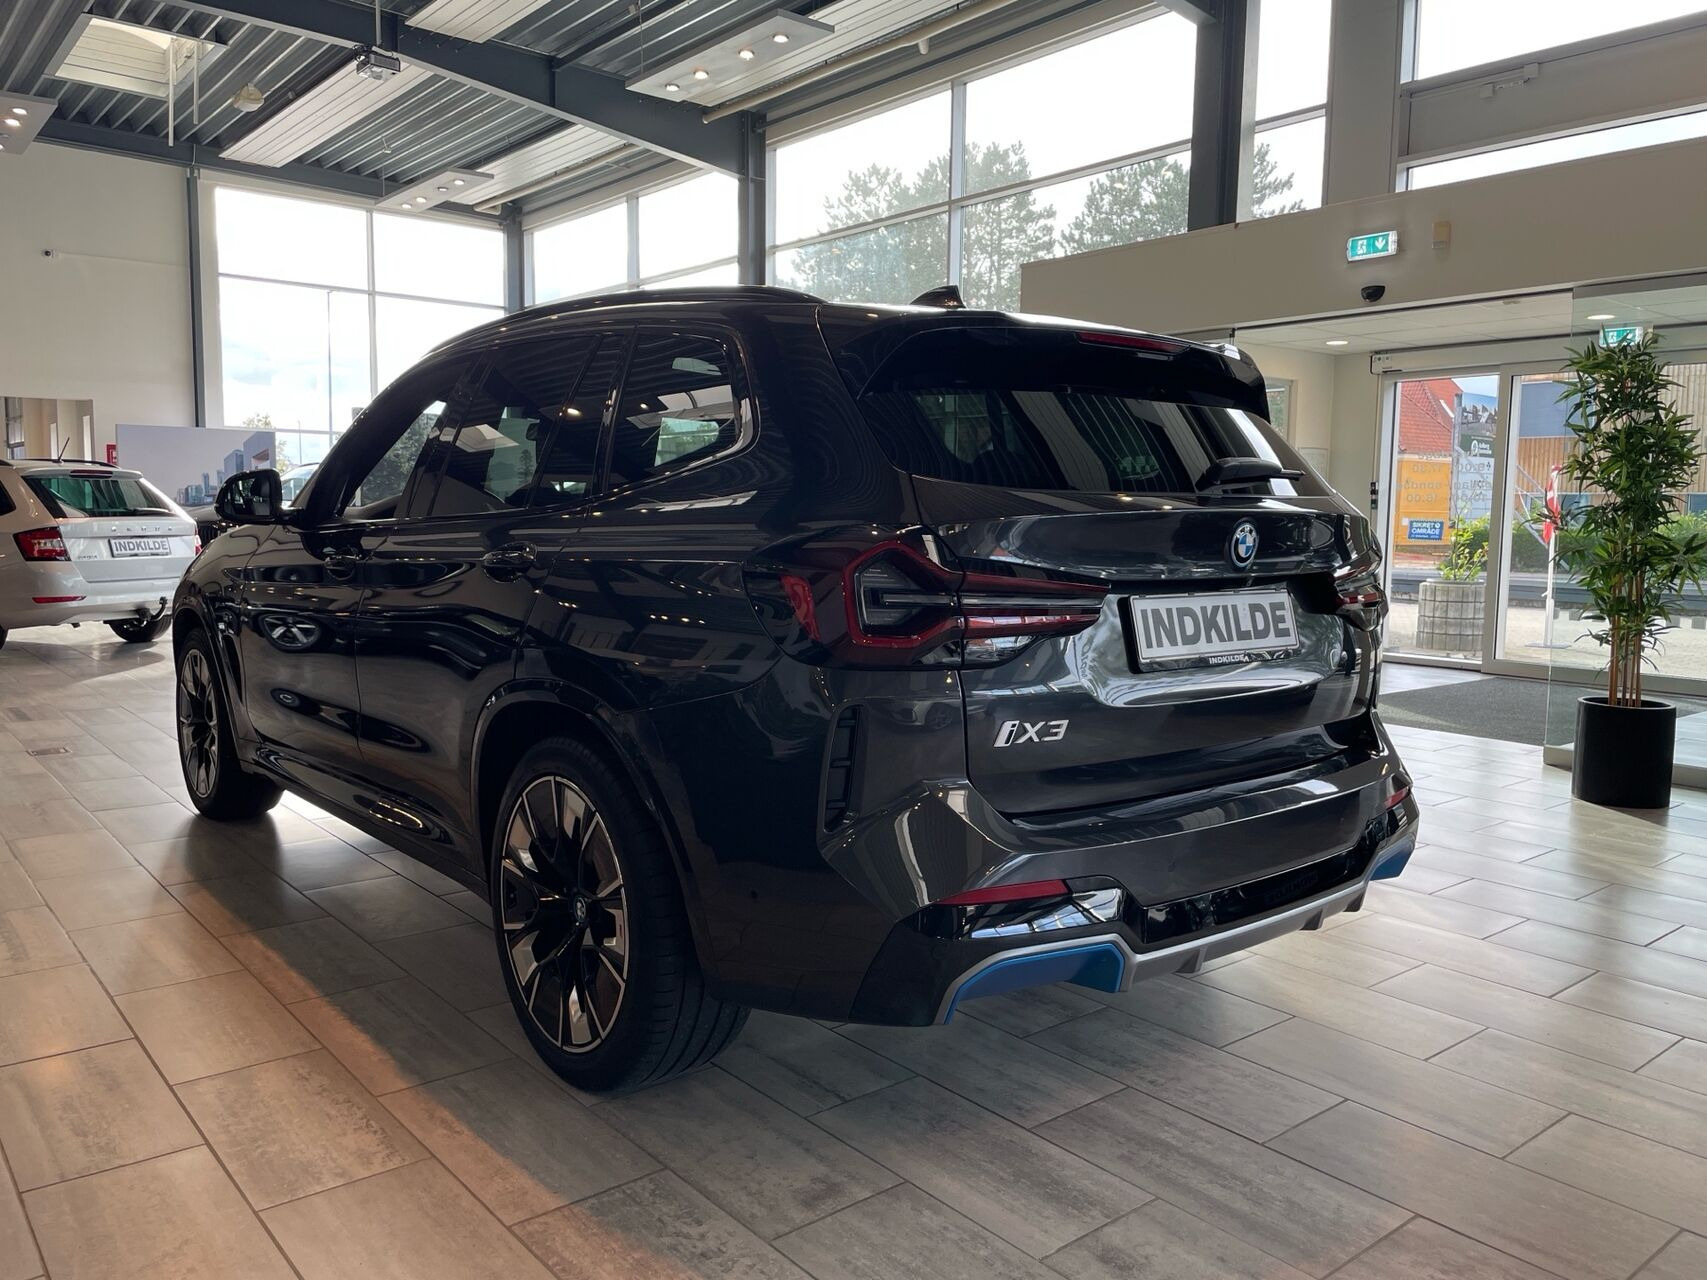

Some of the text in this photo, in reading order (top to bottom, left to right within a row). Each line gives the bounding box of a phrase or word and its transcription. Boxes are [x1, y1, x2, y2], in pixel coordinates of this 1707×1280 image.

[114, 540, 168, 552] INDKILDE
[1140, 601, 1292, 649] INDKILDE
[1208, 654, 1244, 664] INDKILDE
